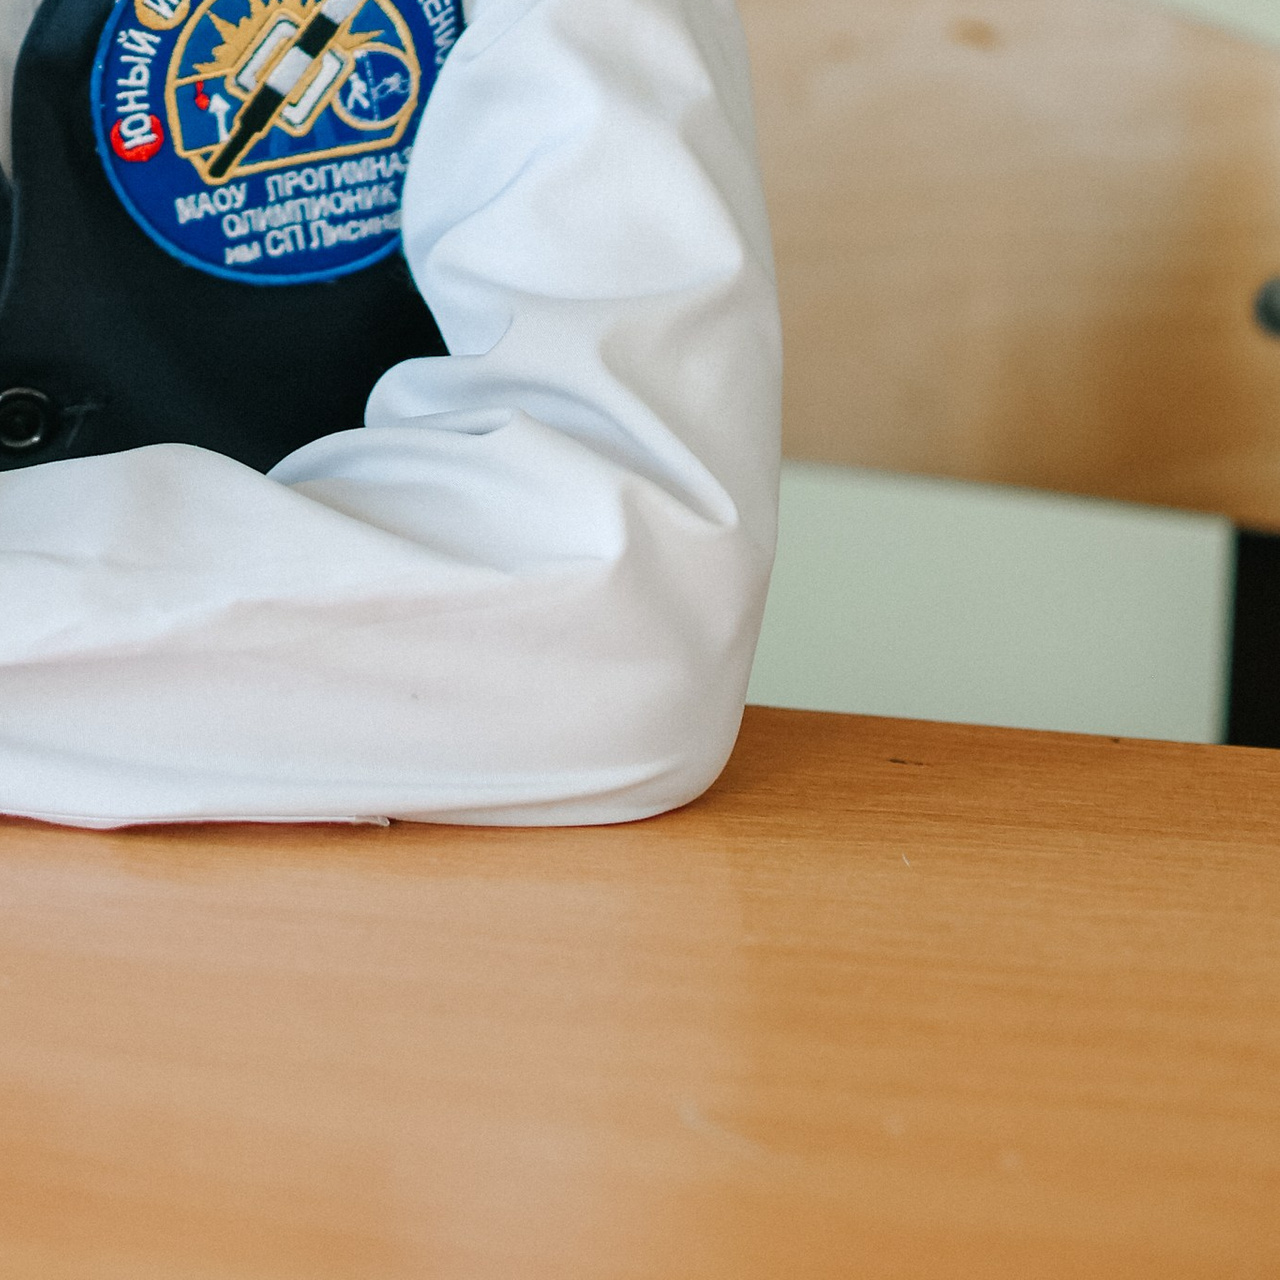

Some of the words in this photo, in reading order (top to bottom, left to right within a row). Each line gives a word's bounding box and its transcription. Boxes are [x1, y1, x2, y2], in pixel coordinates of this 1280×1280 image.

[116, 28, 161, 149] ЮНЫЙ
[175, 182, 247, 224] МАОУ
[222, 181, 398, 238] ОЛИМПИОНИК
[265, 225, 306, 257] СП
